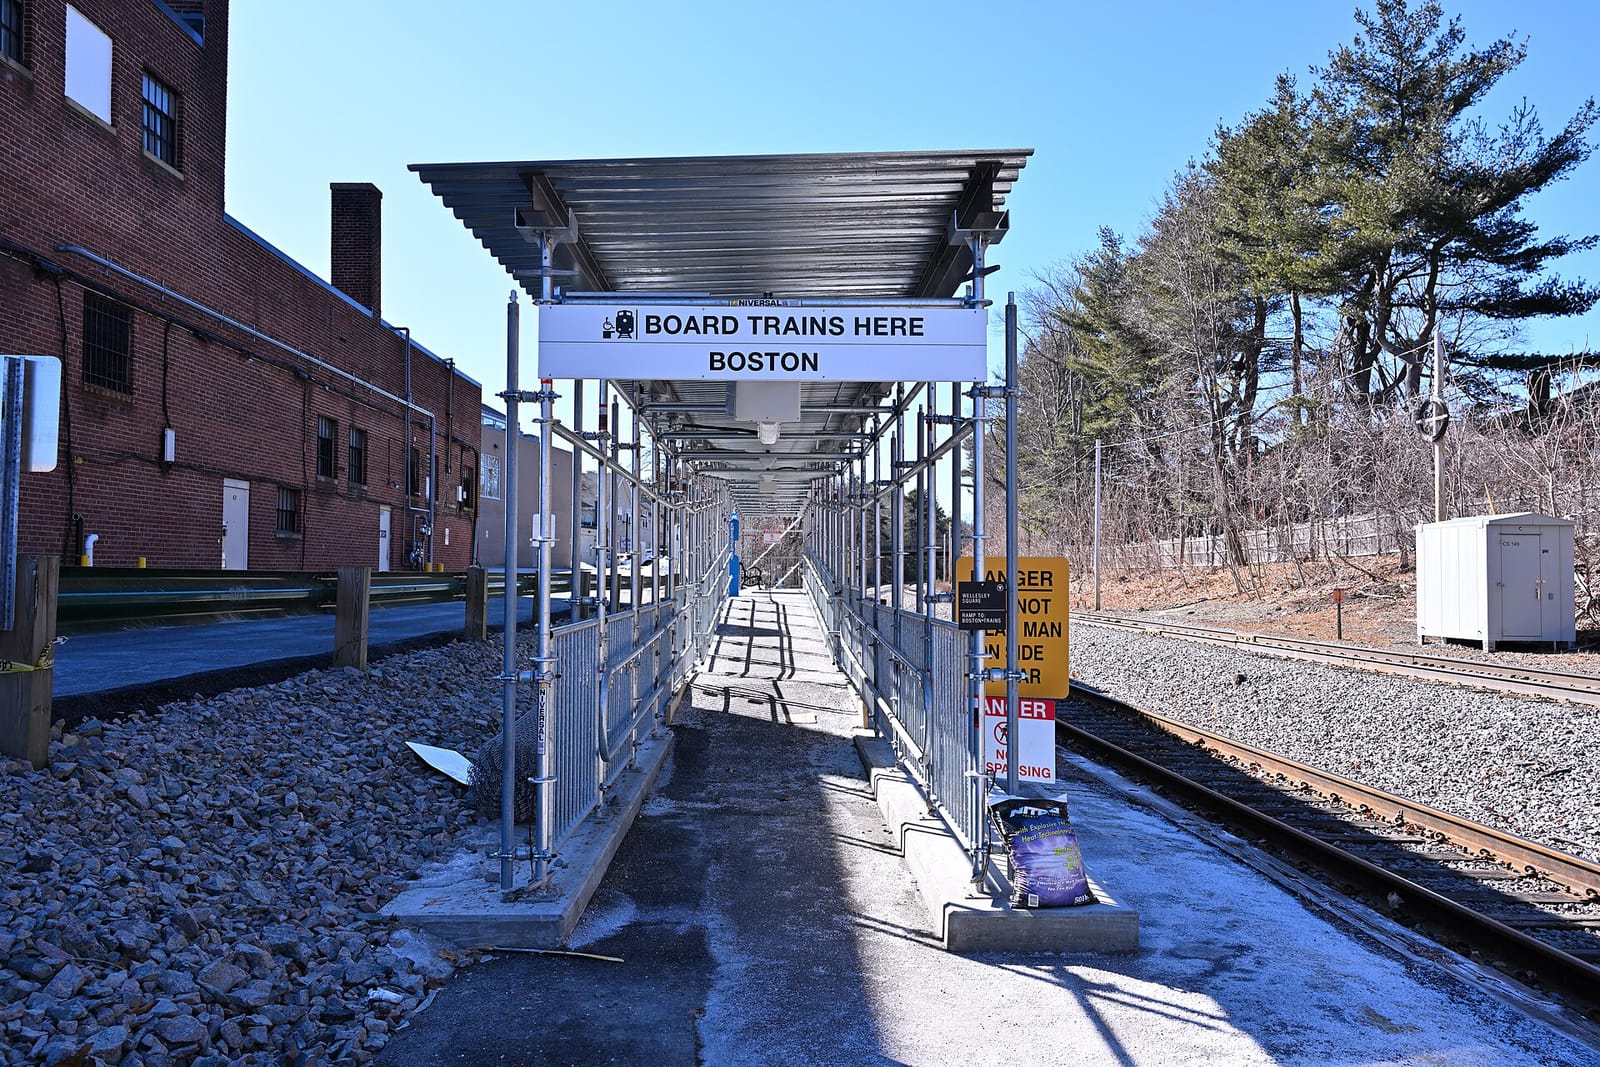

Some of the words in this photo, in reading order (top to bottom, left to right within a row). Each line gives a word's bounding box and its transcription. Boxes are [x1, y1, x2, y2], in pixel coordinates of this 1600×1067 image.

[645, 315, 738, 336] BOARD
[747, 315, 844, 336] TRAINS
[854, 317, 924, 337] HERE
[709, 352, 819, 373] BOSTON
[971, 570, 1053, 587] ANGER
[1017, 598, 1051, 614] NOT
[1023, 622, 1062, 638] MAN
[1006, 645, 1044, 661] IDE
[1015, 668, 1041, 684] AR
[984, 698, 1046, 718] ANER
